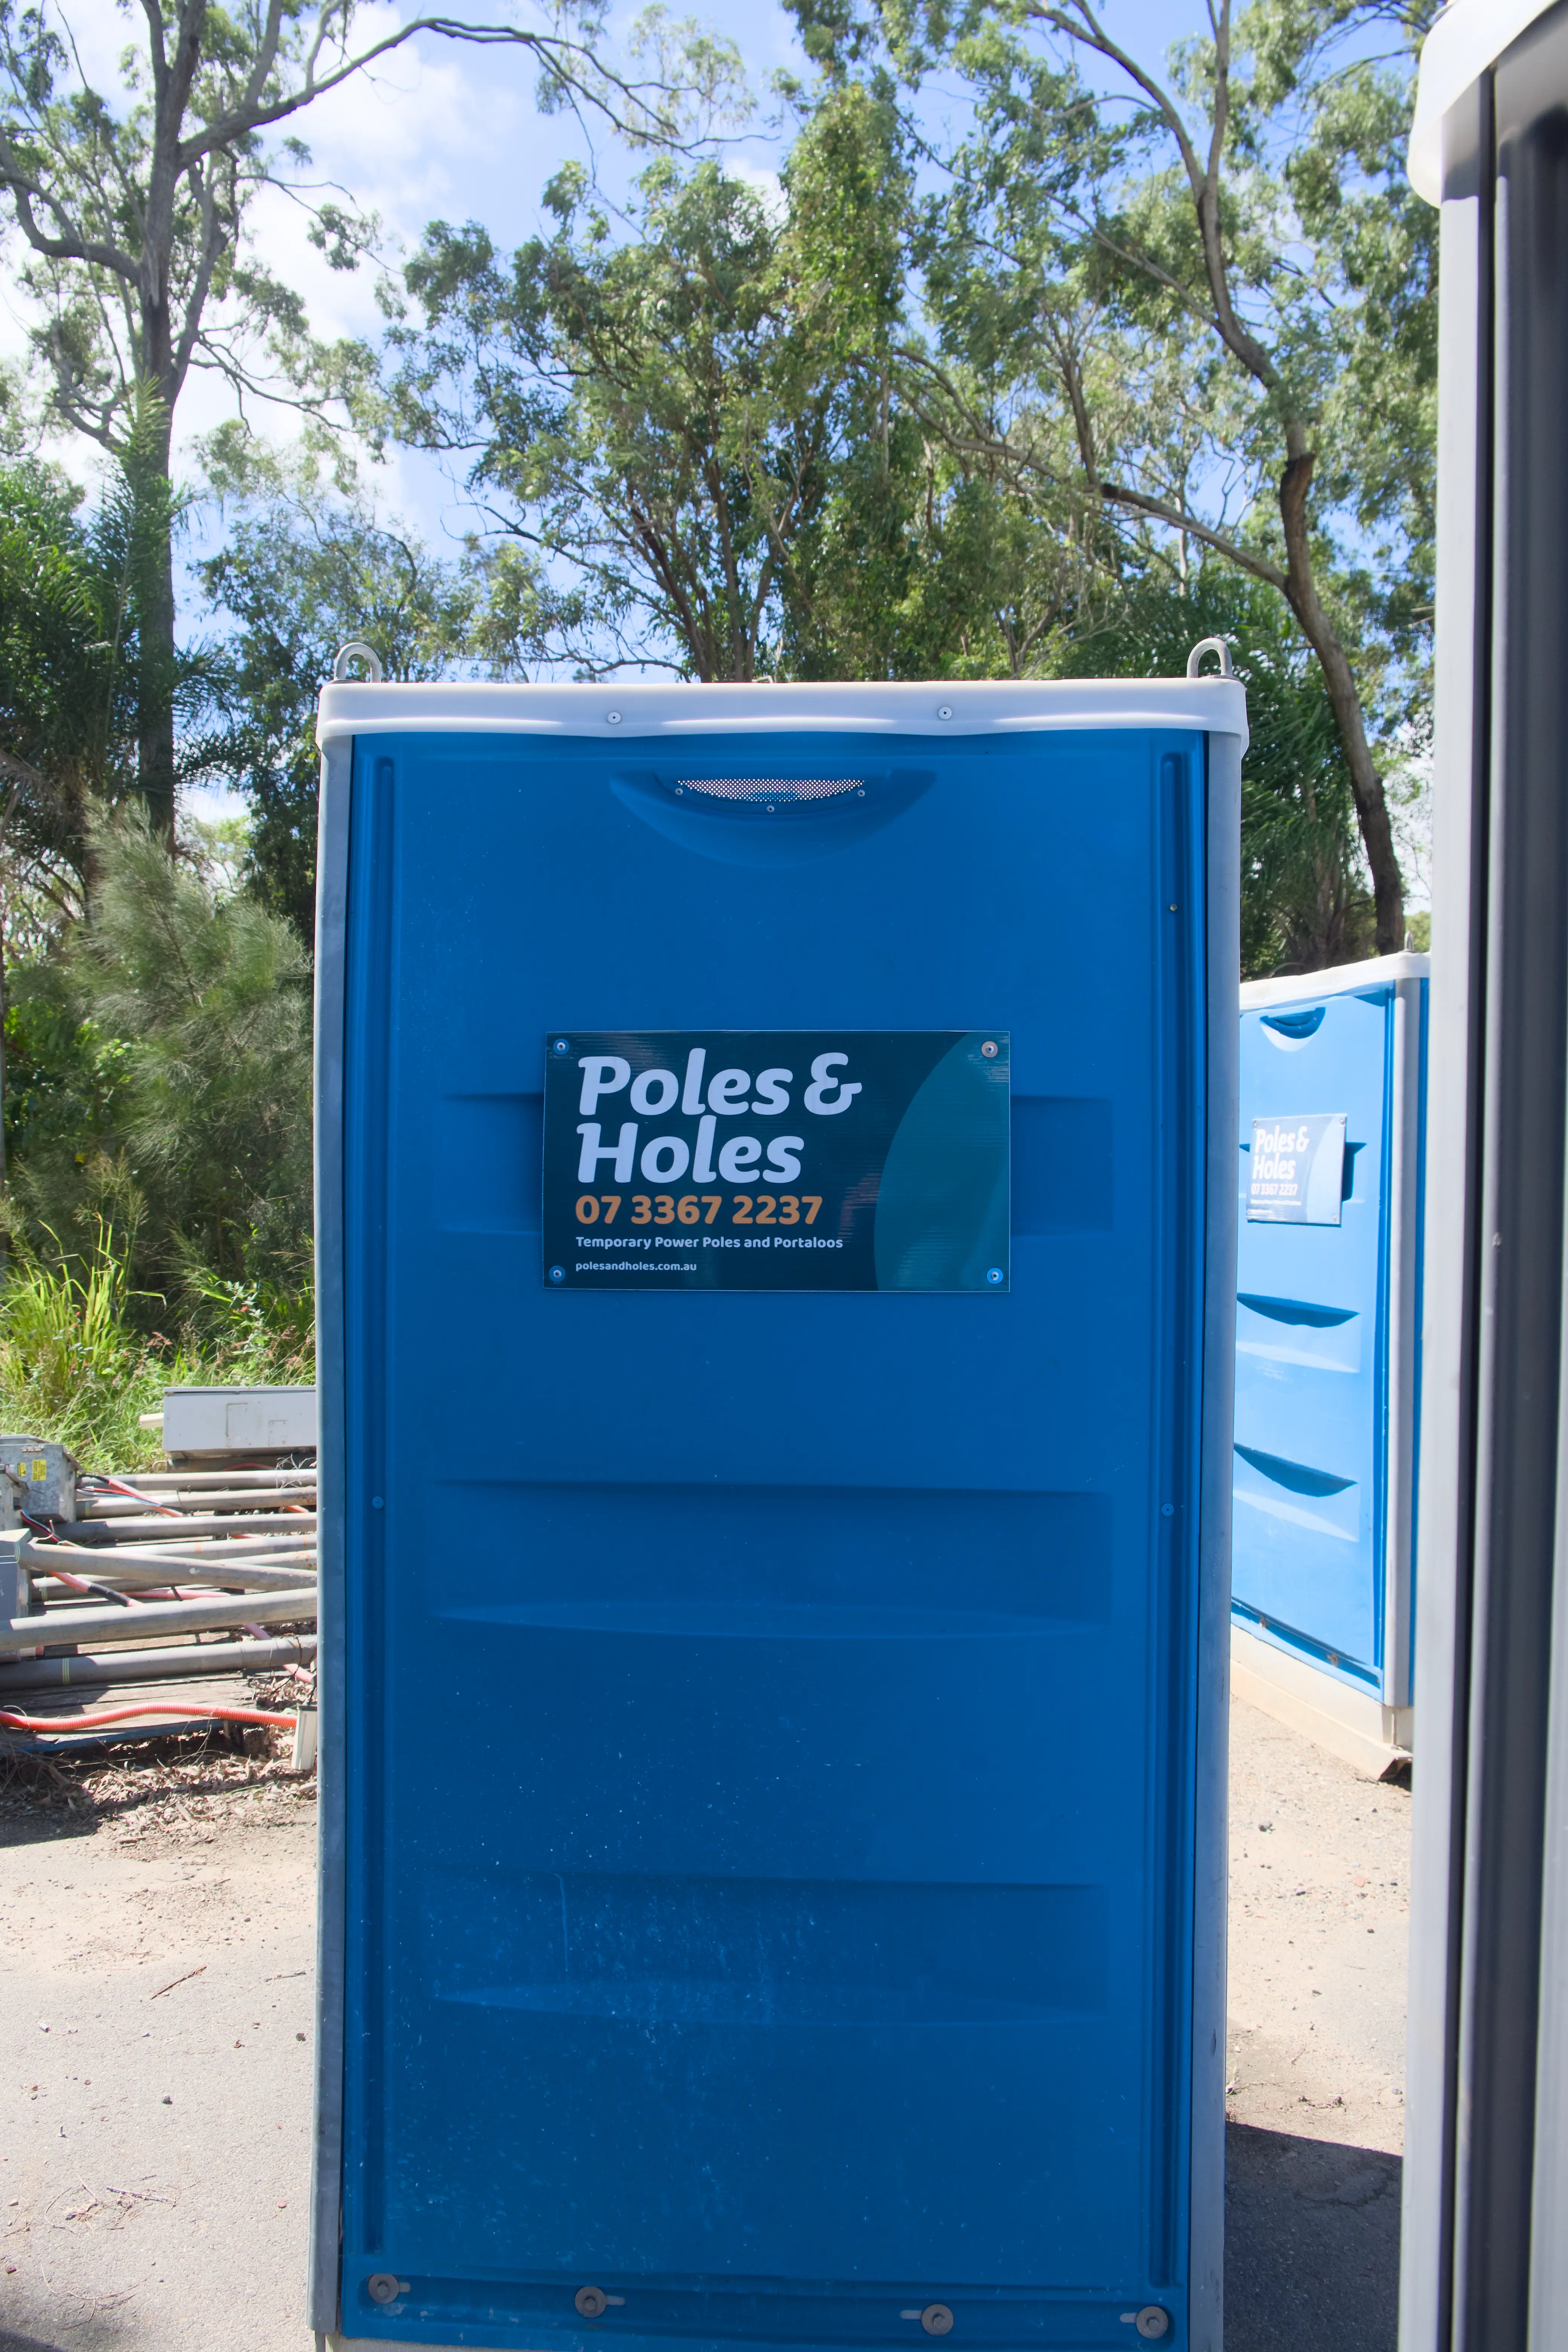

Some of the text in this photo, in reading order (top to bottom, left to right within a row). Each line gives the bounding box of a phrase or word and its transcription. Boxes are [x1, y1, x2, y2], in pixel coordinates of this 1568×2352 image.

[578, 1047, 862, 1115] Poles &
[576, 1115, 804, 1183] Holes
[1254, 1125, 1309, 1153] Poles &
[1252, 1152, 1296, 1179] Holes
[1251, 1183, 1298, 1196] 07 3367 2237
[575, 1195, 822, 1225] 07 3367 2237
[576, 1236, 843, 1250] Temporary Power Poles and Portaloos
[575, 1261, 697, 1271] polesandholes.com.au
